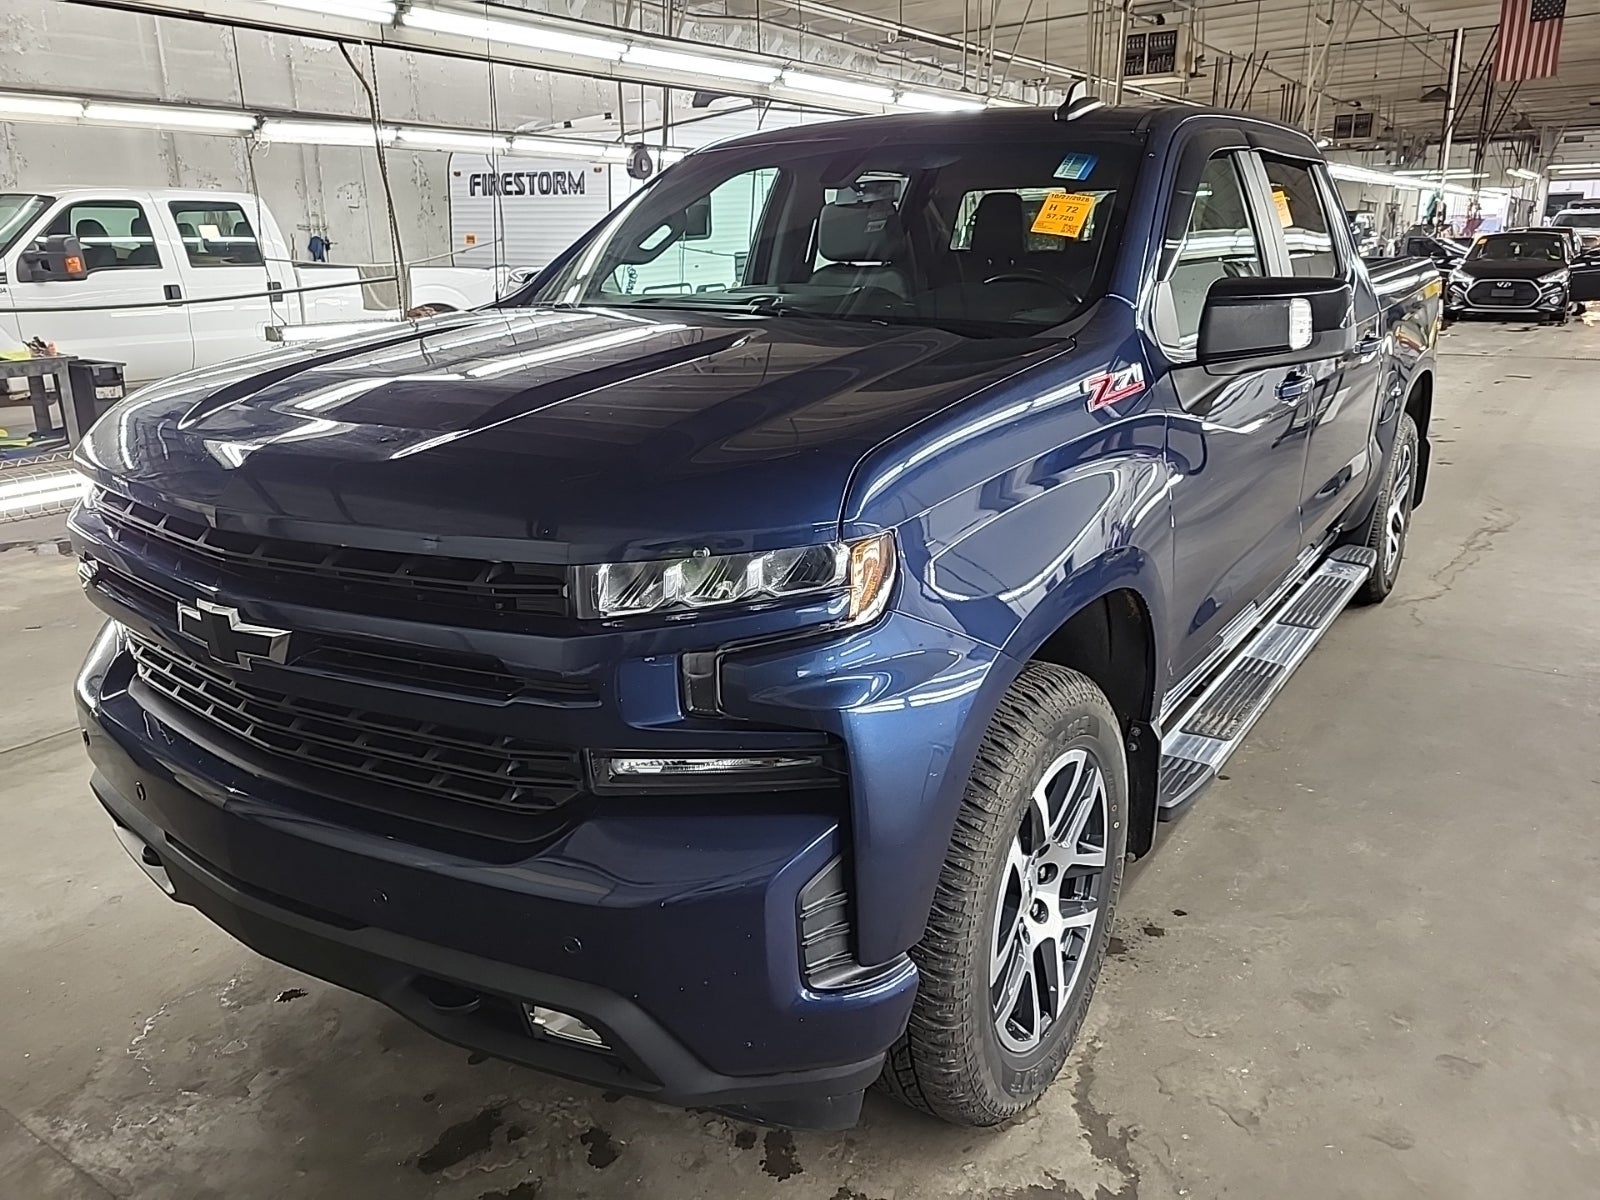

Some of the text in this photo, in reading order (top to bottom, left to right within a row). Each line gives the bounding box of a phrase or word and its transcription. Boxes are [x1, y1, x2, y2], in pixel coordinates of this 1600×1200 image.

[469, 171, 585, 197] FIRESTORM
[1048, 203, 1079, 214] H 72
[1082, 362, 1146, 413] Z71
